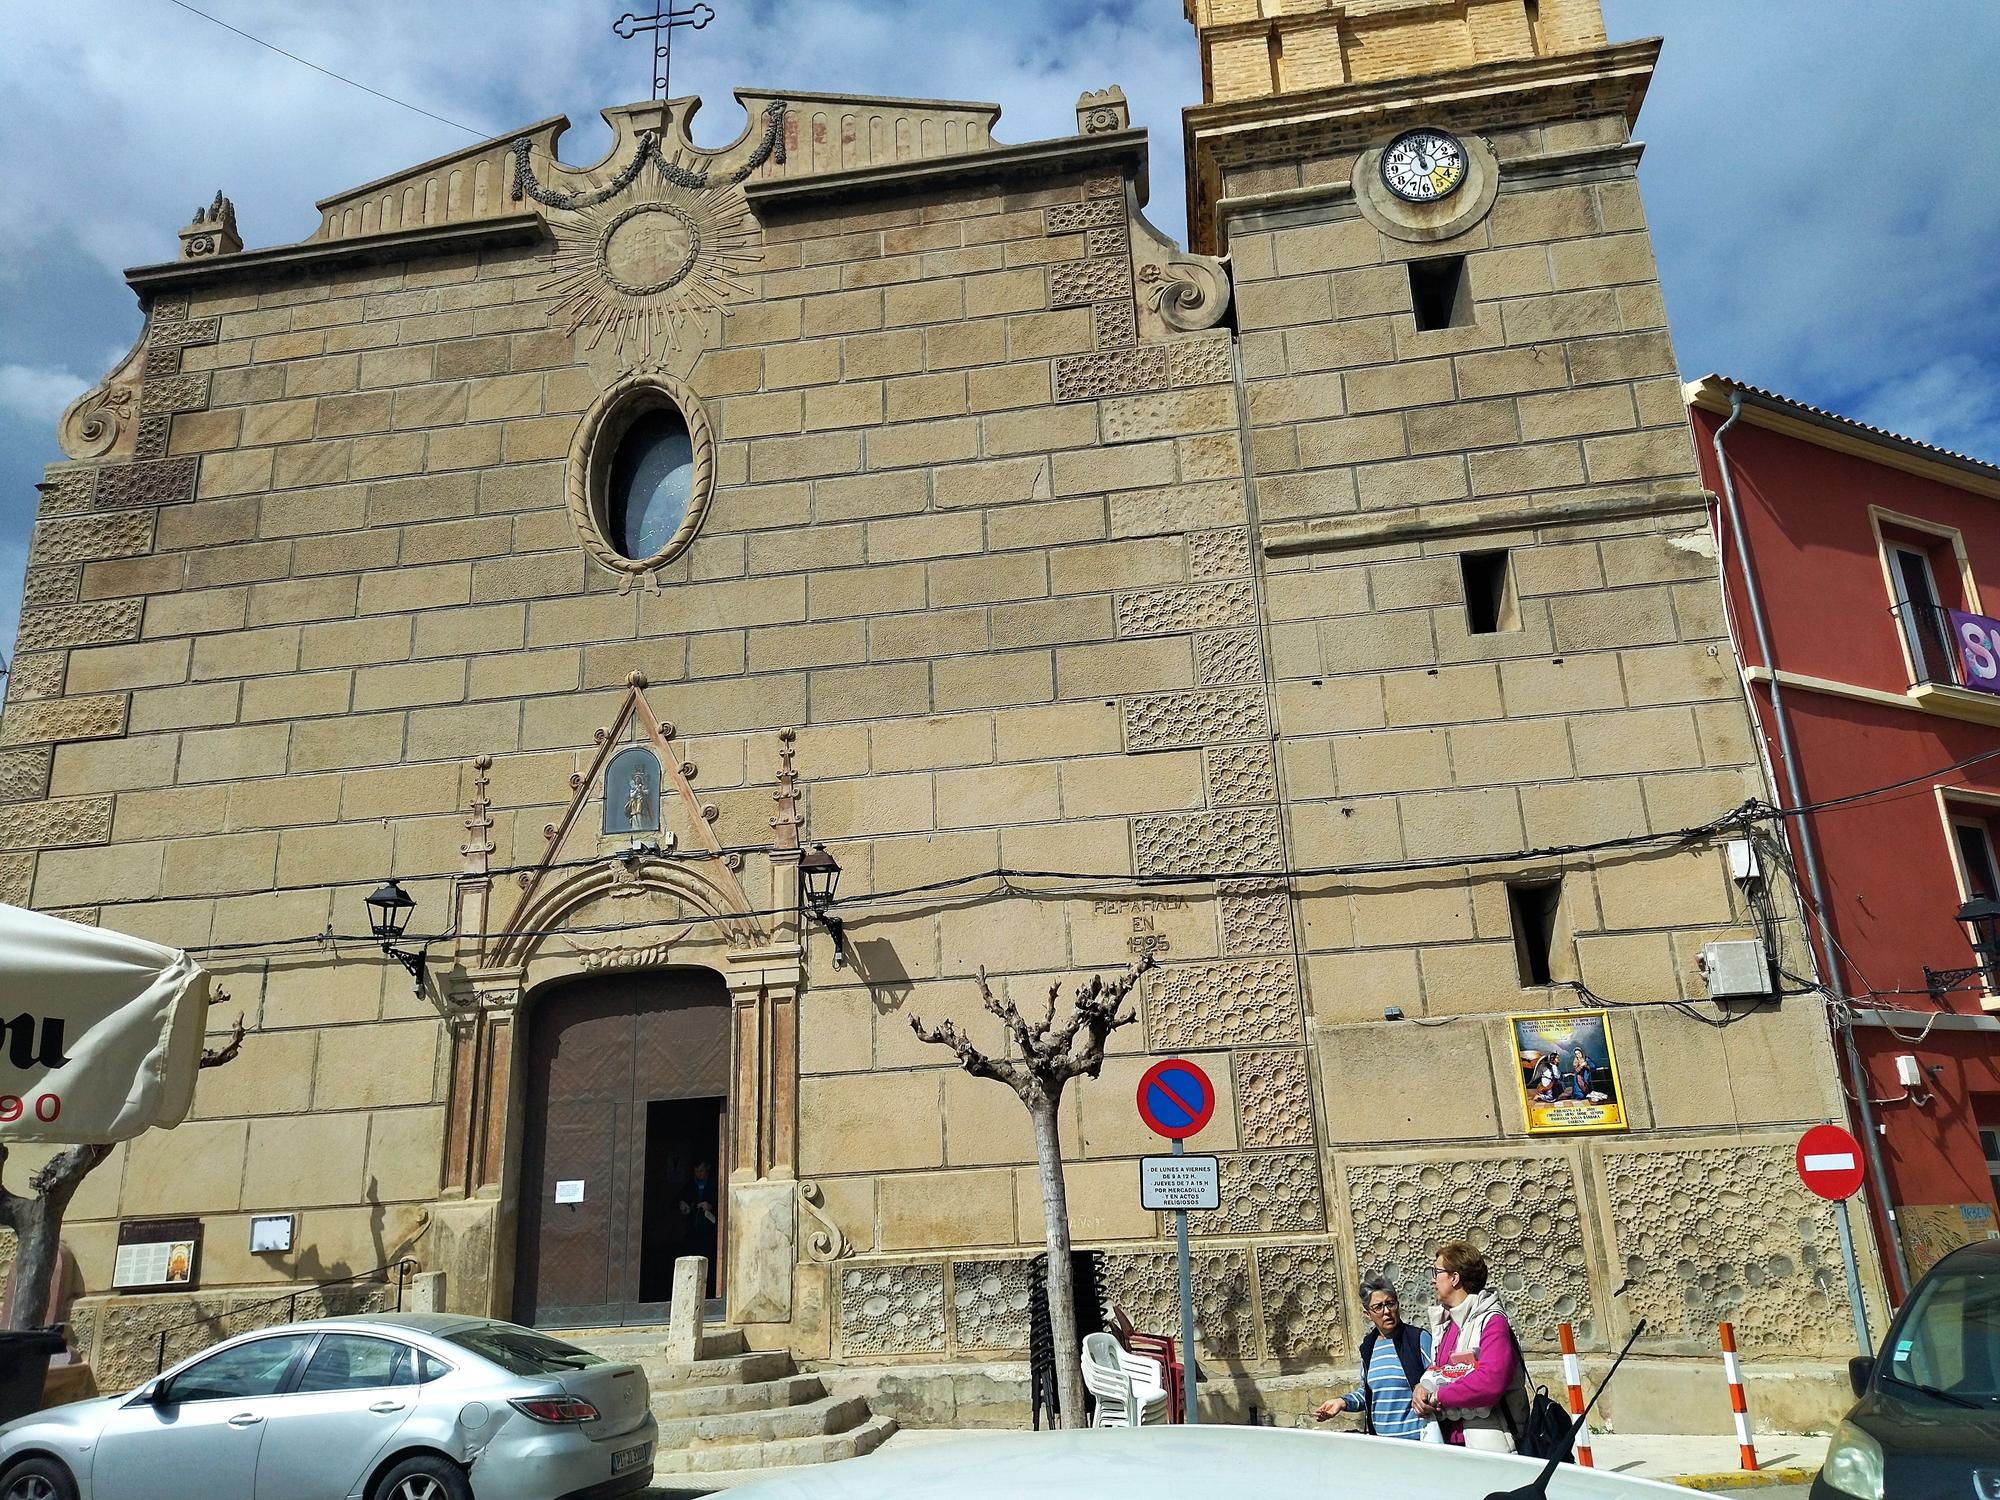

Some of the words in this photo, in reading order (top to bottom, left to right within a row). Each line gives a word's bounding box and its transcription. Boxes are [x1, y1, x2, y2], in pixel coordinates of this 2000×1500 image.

[1431, 141, 1436, 149] 1
[1440, 146, 1448, 155] 2
[1393, 153, 1403, 162] 10
[1447, 157, 1455, 167] 3
[1391, 165, 1399, 174] 9
[1443, 168, 1452, 178] 4
[1397, 175, 1405, 185] 8
[1435, 178, 1443, 188] 5
[1409, 181, 1417, 191] 7
[1422, 183, 1430, 193] 6
[1095, 895, 1189, 914] REPARADA
[1132, 915, 1154, 932] EN
